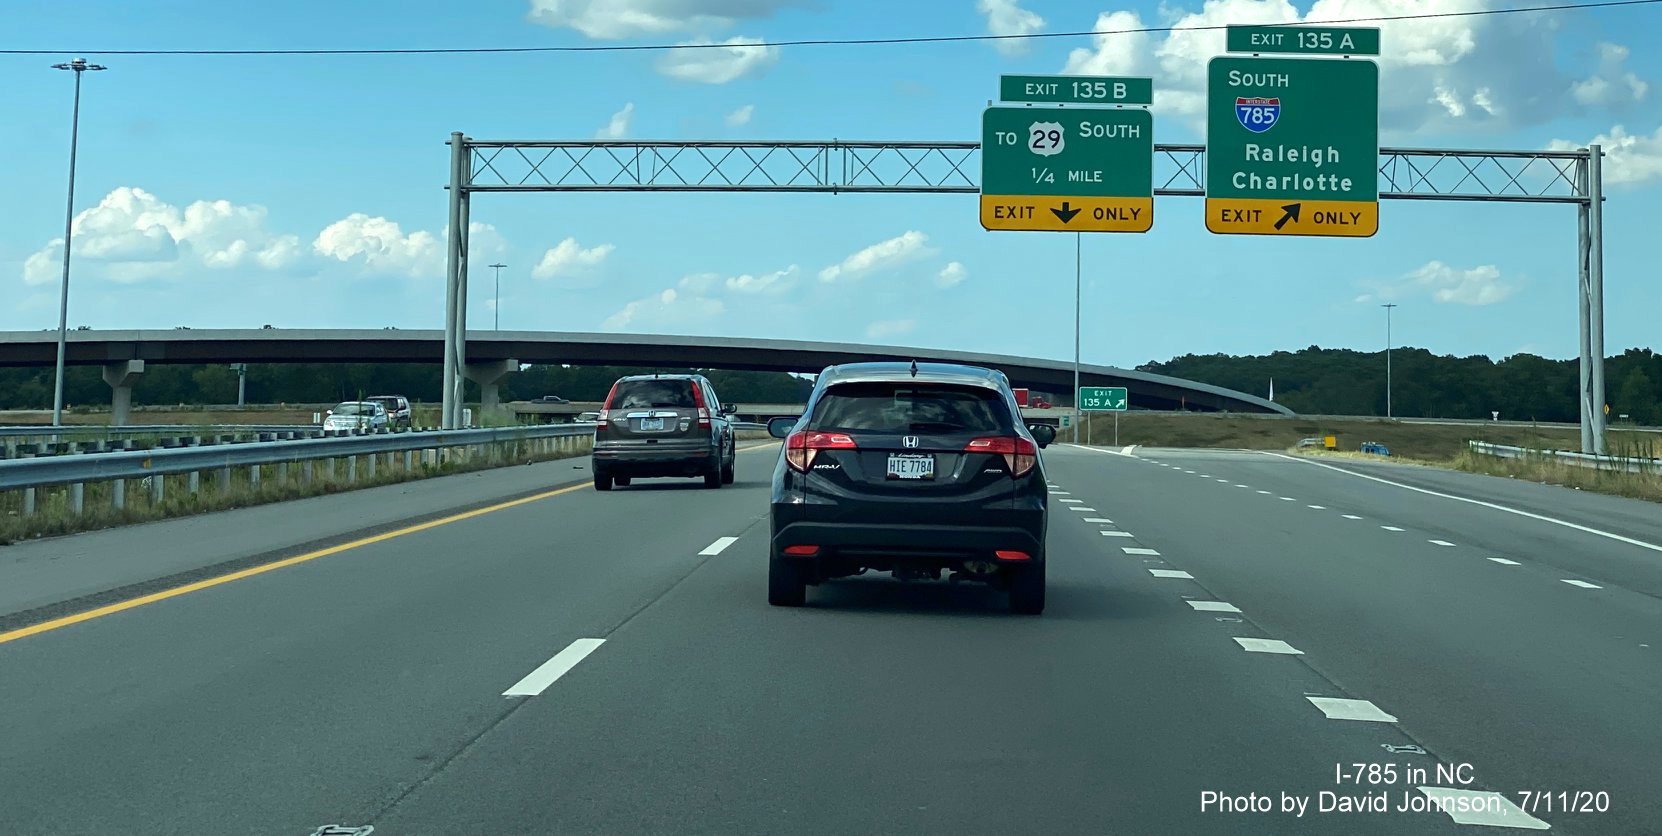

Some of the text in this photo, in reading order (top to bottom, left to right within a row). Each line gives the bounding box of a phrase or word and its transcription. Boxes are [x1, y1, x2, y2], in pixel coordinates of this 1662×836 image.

[1251, 32, 1355, 49] EXIT 135 A
[1228, 70, 1289, 87] SOUTH
[1025, 82, 1127, 98] EXIT 135 B
[1240, 107, 1275, 124] 785
[995, 121, 1140, 149] TO 29 SOUTH
[1245, 144, 1339, 168] Raleigh
[1032, 167, 1103, 183] 1/4 MILE
[1232, 171, 1352, 191] Charlotte
[994, 206, 1141, 220] EXIT ONLY
[1221, 209, 1361, 225] EXIT ONLY
[1083, 398, 1112, 407] 135 A
[889, 460, 931, 472] HIE 7784
